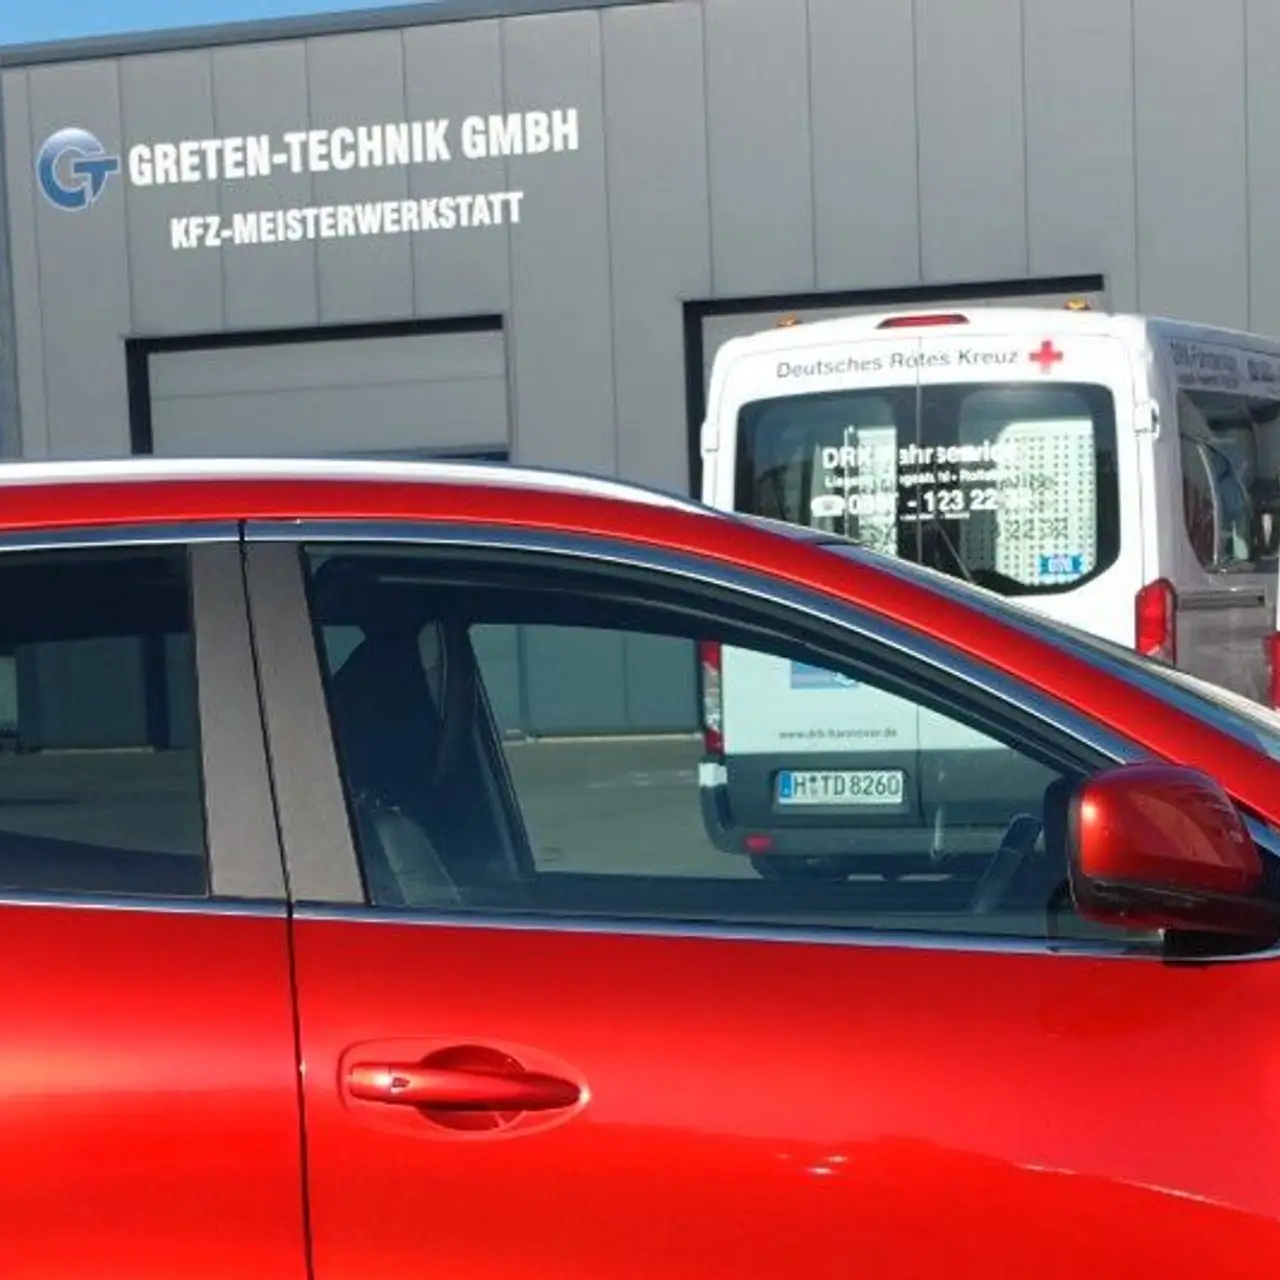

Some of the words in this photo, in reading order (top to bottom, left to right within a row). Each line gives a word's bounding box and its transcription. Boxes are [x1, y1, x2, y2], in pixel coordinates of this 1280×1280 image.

[128, 118, 451, 186] GRETEN-TECHNIK
[460, 108, 580, 160] GMBH
[170, 190, 524, 251] KFZ-MEISTERWERKSTATT
[776, 356, 883, 379] Deutsches
[889, 352, 950, 369] Rotes
[959, 349, 1019, 365] Kreuz
[923, 489, 965, 512] 123
[849, 775, 901, 796] 8260
